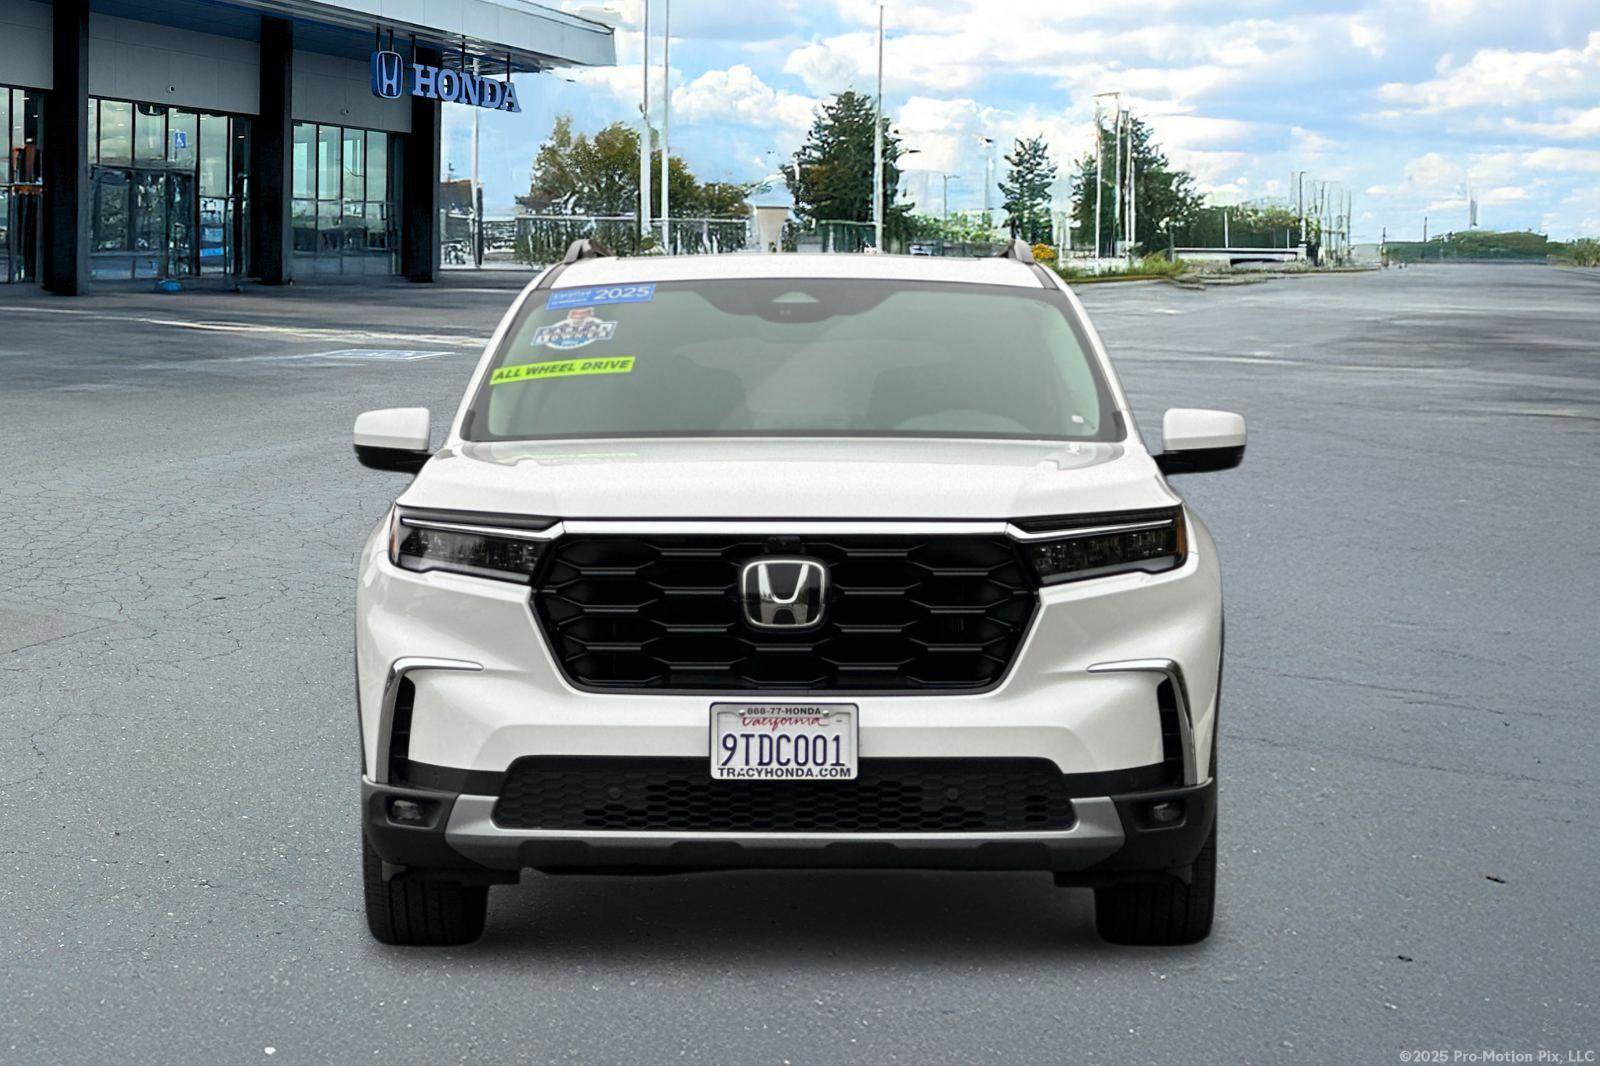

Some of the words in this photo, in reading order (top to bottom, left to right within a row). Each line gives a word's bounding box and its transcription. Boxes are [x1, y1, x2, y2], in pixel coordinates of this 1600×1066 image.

[411, 62, 522, 113] HONDA
[594, 286, 650, 301] 2025
[494, 367, 521, 380] ALL
[525, 363, 576, 376] WHEEL
[580, 359, 632, 371] DRIVE
[747, 707, 822, 716] 888-77-HONDA
[721, 733, 846, 767] 9TDC001
[718, 767, 852, 778] TRACYHONDA.COM
